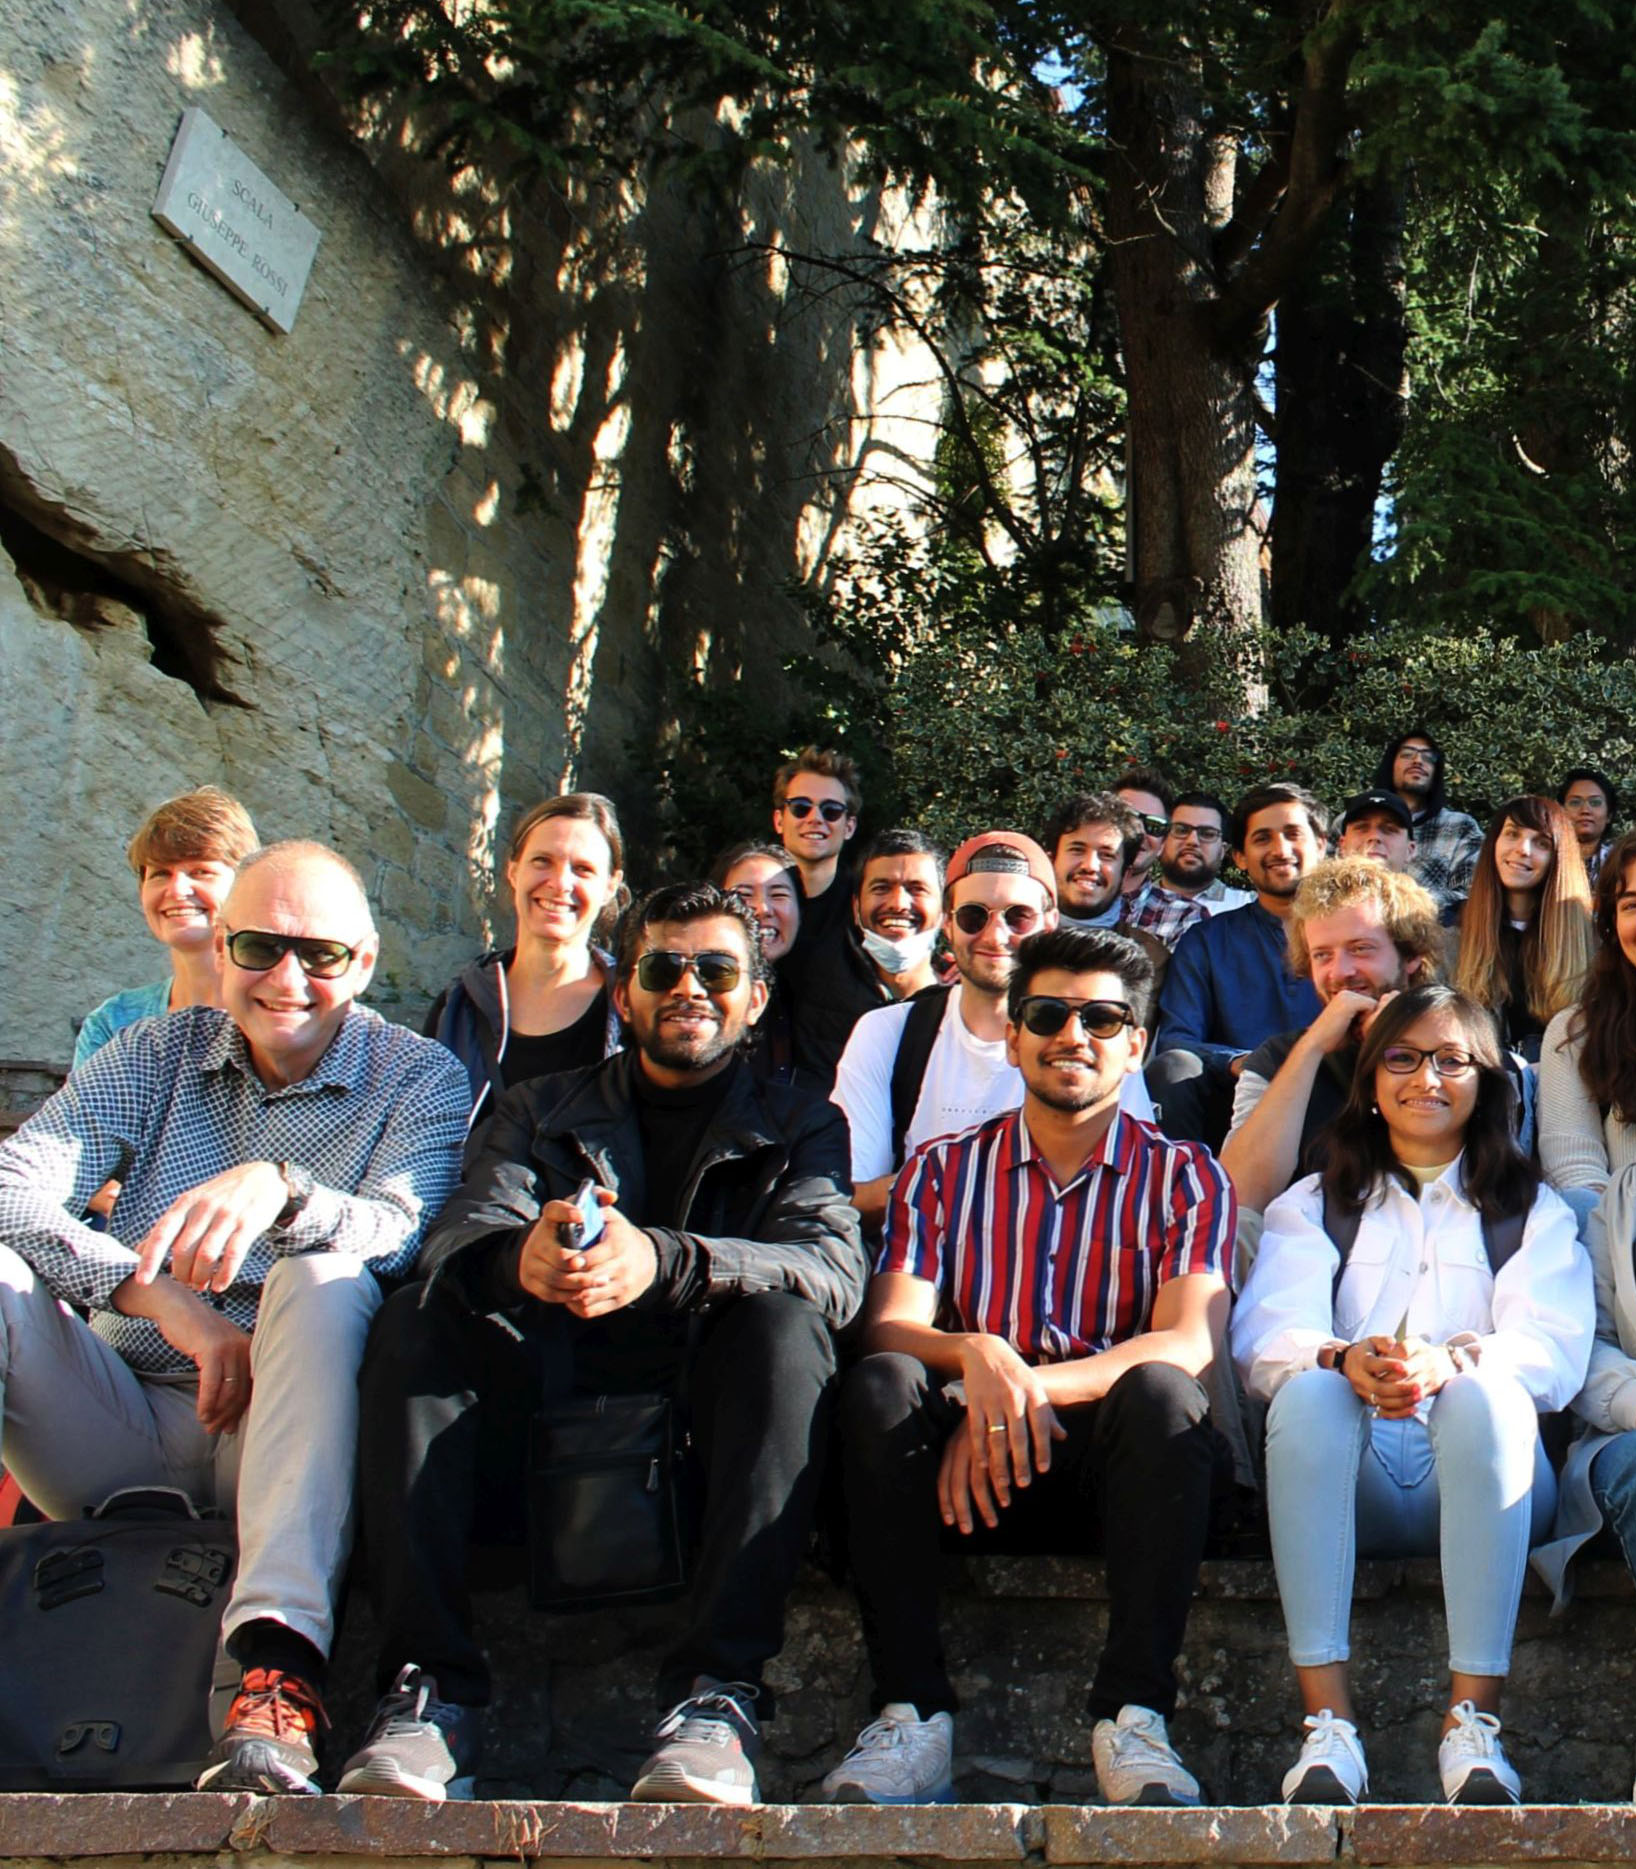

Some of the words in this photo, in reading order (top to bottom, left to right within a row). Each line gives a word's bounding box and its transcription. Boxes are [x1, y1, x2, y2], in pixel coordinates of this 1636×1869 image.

[231, 180, 273, 230] SCALA
[188, 192, 248, 258] GIUSEPPE
[251, 253, 289, 297] ROSSI
